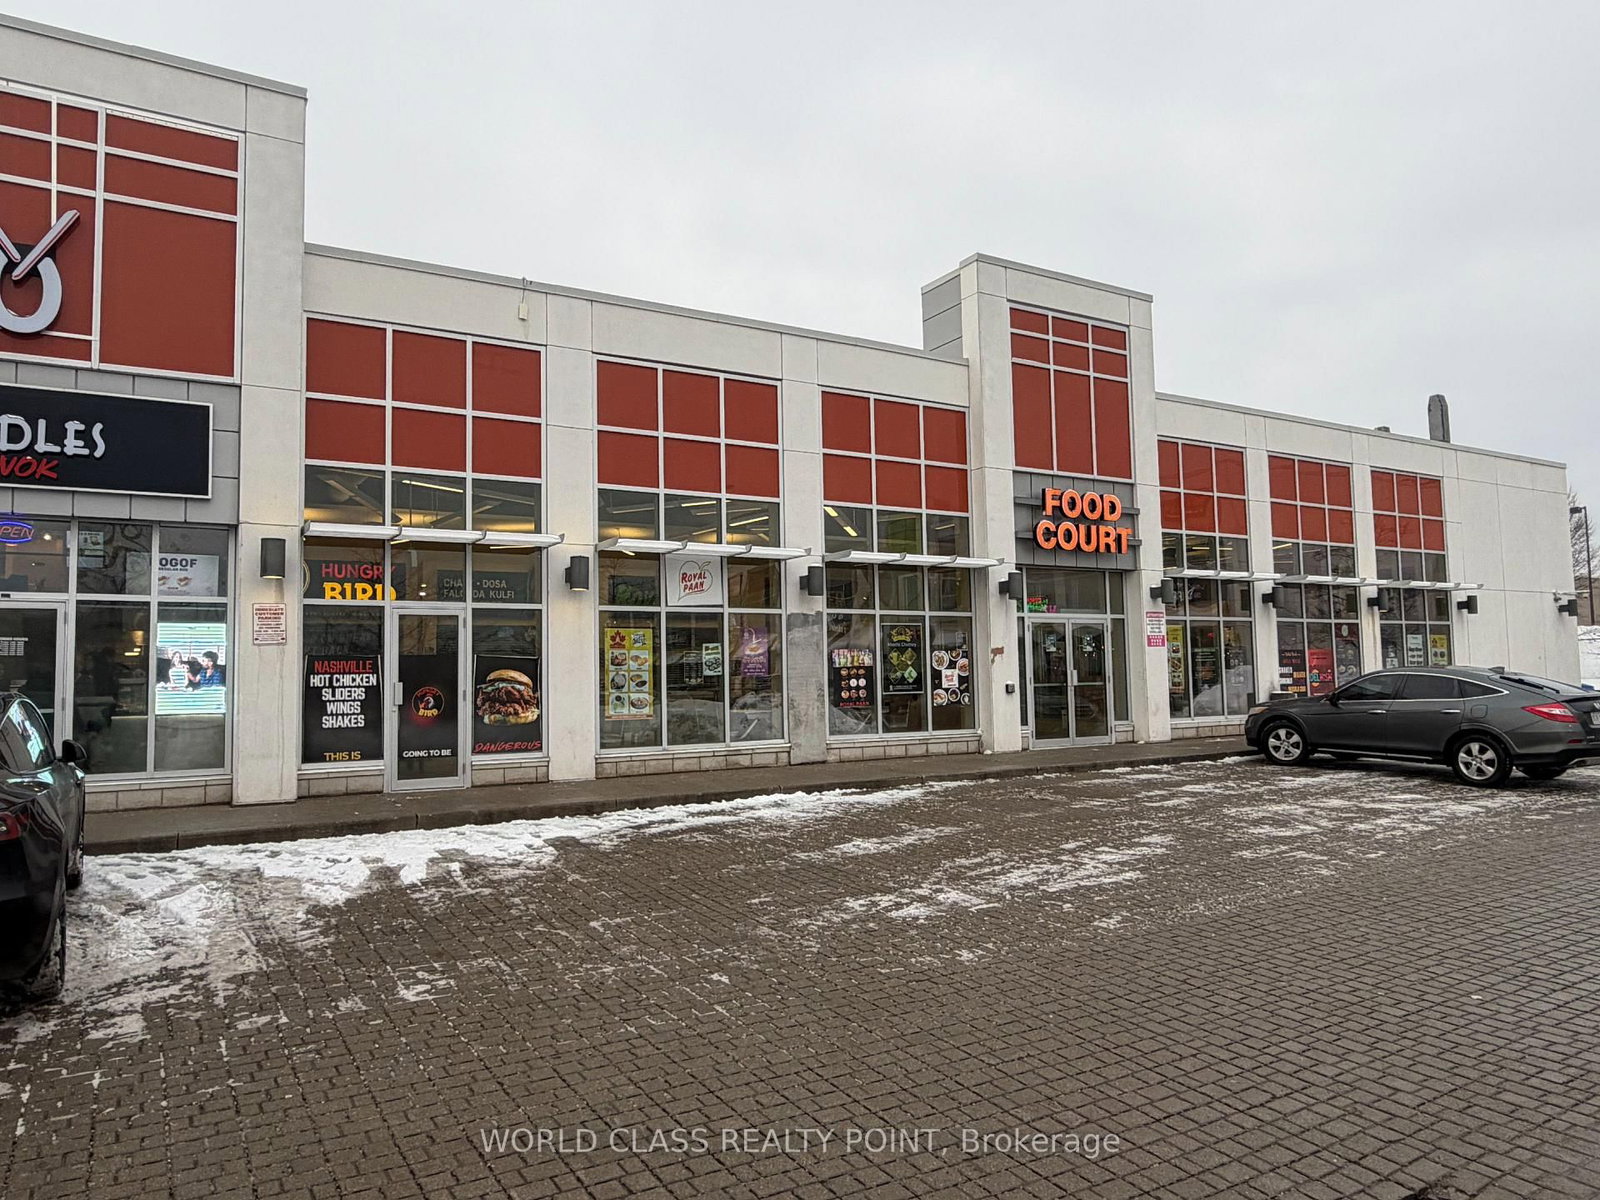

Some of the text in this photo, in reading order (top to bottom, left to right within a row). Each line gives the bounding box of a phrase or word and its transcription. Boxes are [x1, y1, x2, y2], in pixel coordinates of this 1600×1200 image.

[0, 414, 106, 458] DLES
[1043, 488, 1122, 521] FOOD
[1035, 519, 1133, 554] COURT
[483, 580, 507, 588] DOSA
[681, 571, 707, 584] ROYAL
[683, 580, 705, 592] PAAN
[314, 660, 373, 674] NASHVILLE
[310, 674, 377, 687] HOT CHICKEN
[322, 688, 365, 701] SLIDERS
[326, 701, 361, 714] WINGS
[322, 715, 365, 728] SHAKES
[403, 749, 428, 757] GOING
[429, 749, 441, 757] TO
[474, 740, 542, 753] DANGEROUS
[324, 751, 361, 761] THIS IS
